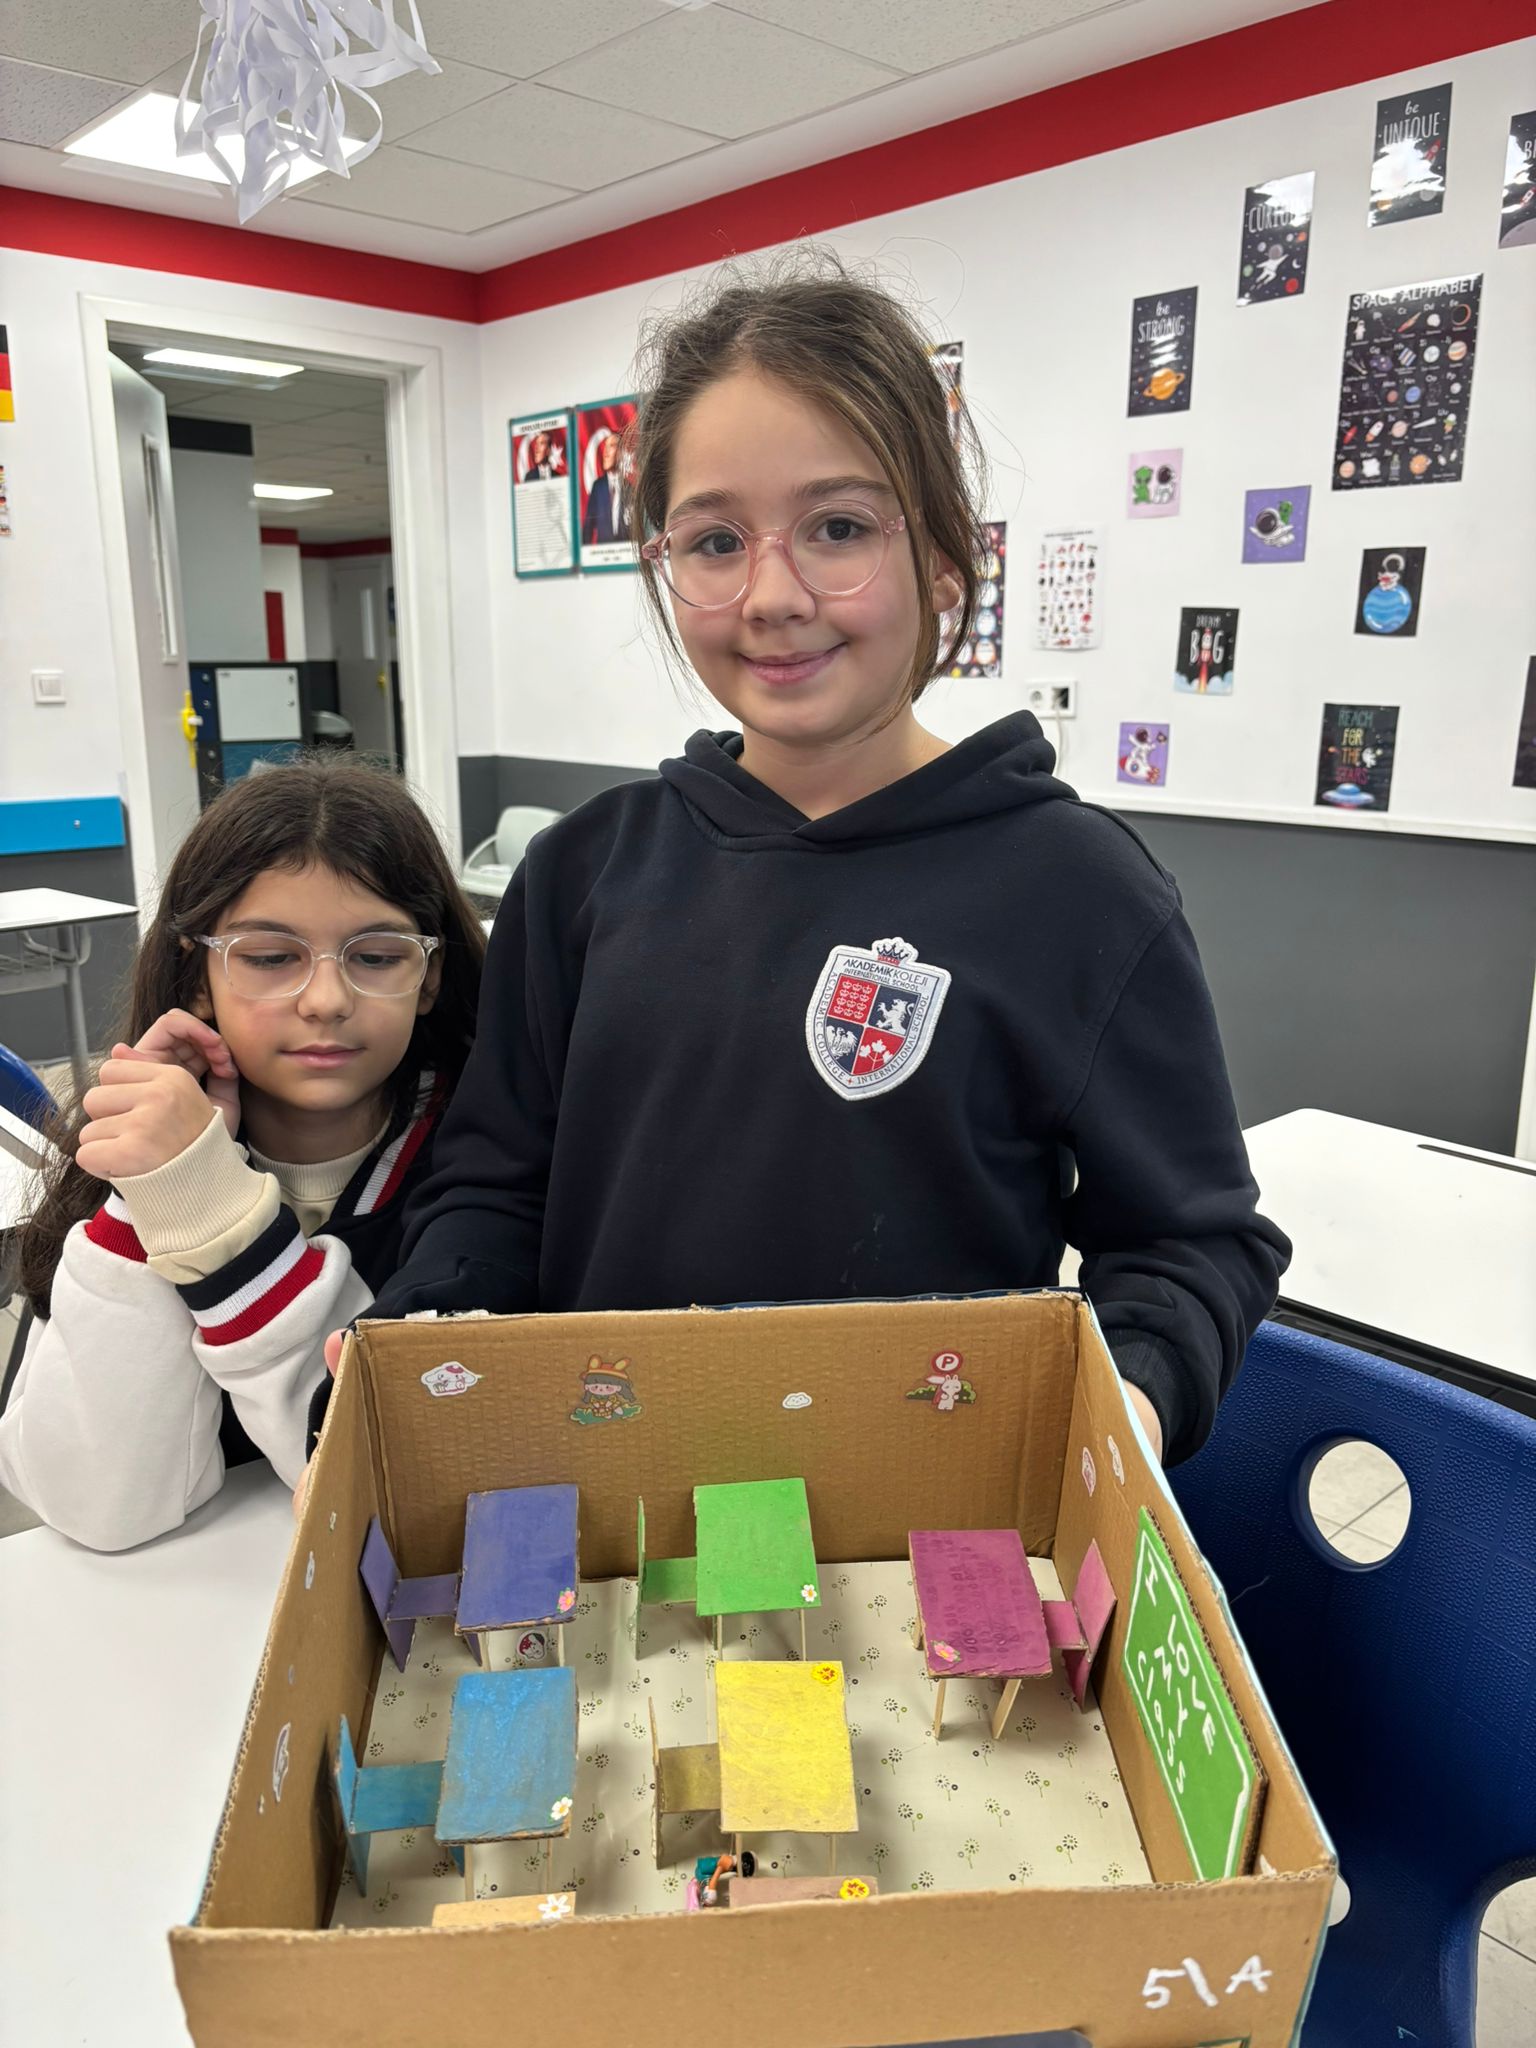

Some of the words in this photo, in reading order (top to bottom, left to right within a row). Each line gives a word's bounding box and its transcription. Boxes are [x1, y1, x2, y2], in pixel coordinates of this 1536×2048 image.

[1405, 101, 1420, 115] be
[1383, 112, 1440, 146] UNIQUE
[1352, 292, 1396, 311] SPACE
[1400, 279, 1476, 302] ALPHABET
[1137, 314, 1185, 343] STRONG
[1342, 727, 1364, 746] FOR
[1342, 747, 1360, 764] THE
[844, 968, 891, 985] INTERNATIONAL
[892, 980, 919, 991] SCHOOL
[816, 972, 838, 1026] ACADEMIC
[857, 1036, 916, 1084] INTERNATIONAL
[913, 995, 929, 1032] SCHOOL
[817, 1033, 844, 1080] COLLEGE
[941, 1356, 955, 1369] P
[1167, 1613, 1216, 1755] LOVE
